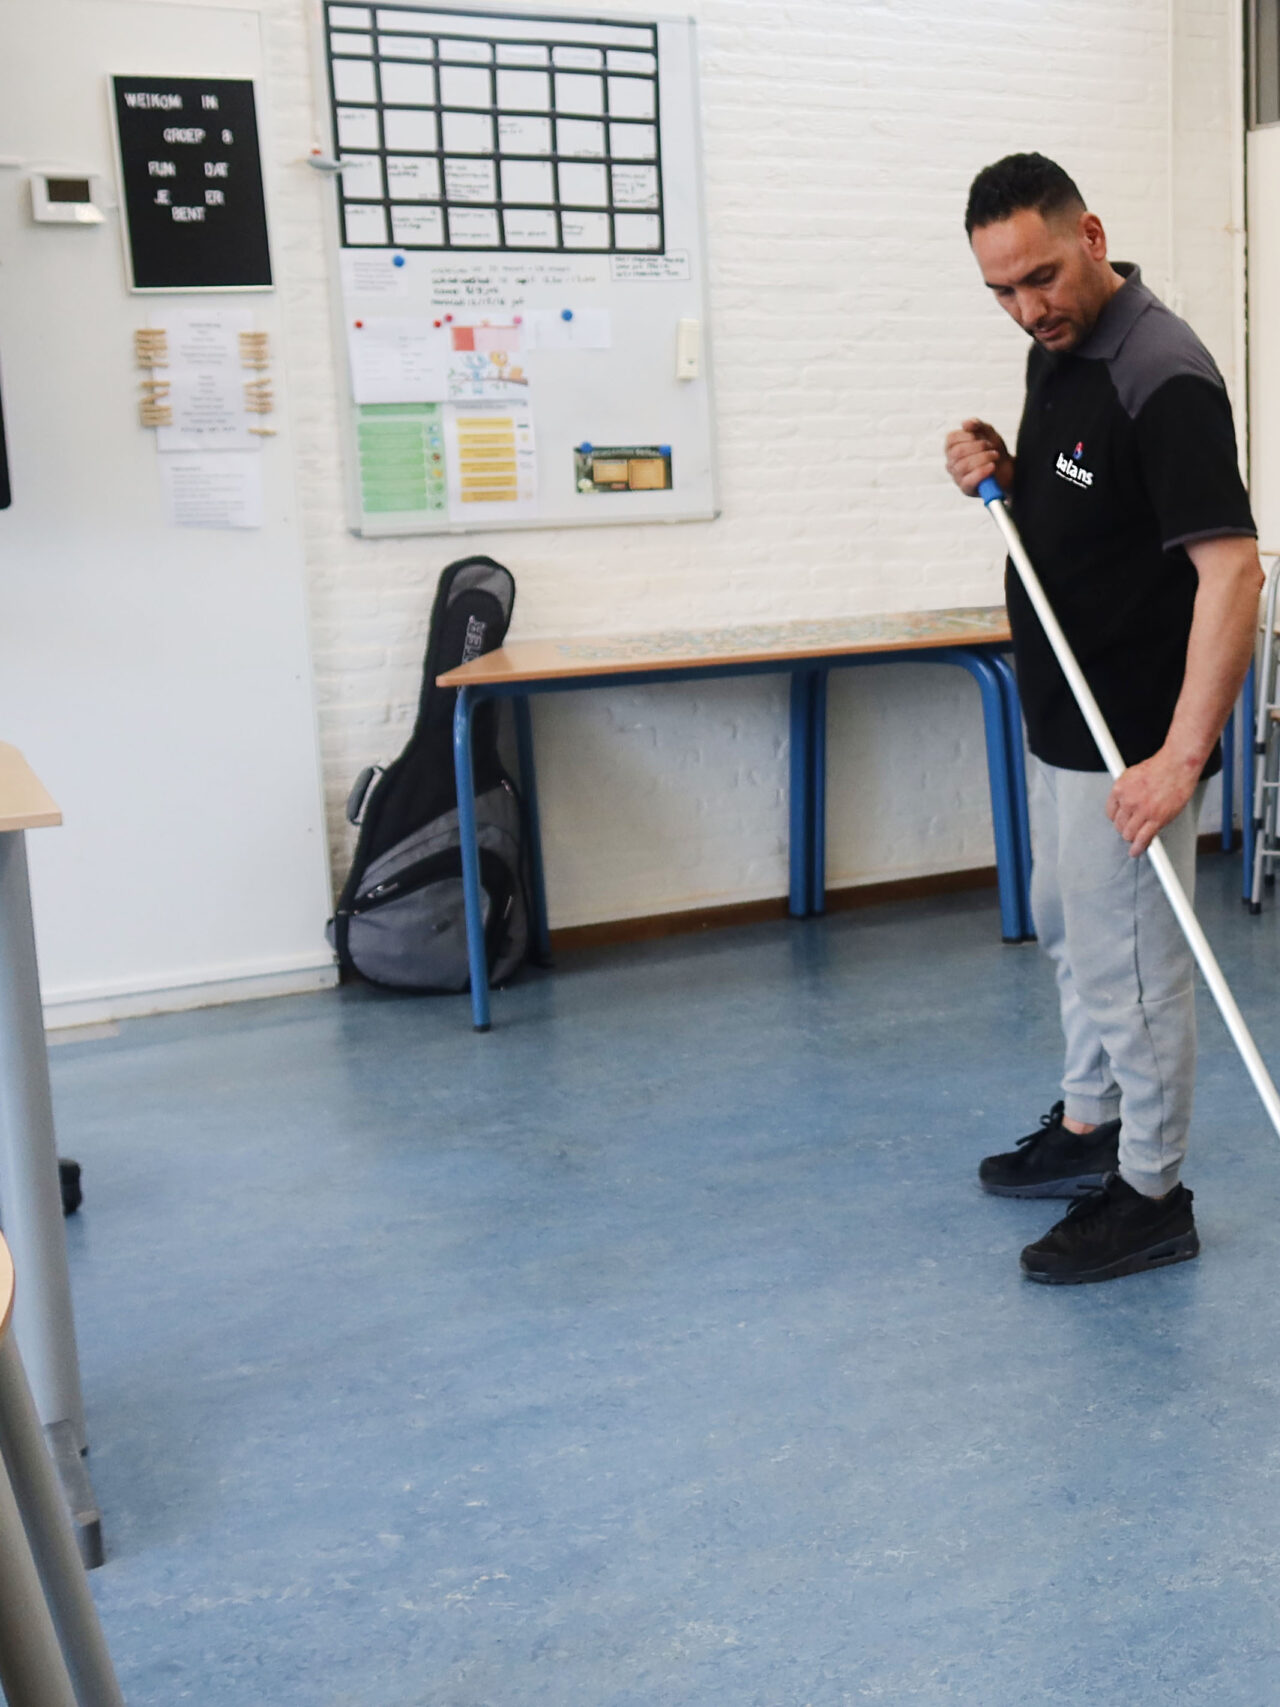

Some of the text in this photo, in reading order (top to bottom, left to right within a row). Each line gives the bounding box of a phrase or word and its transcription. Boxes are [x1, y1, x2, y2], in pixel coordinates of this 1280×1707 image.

[201, 94, 219, 110] IN
[163, 127, 206, 144] GROEP
[204, 161, 229, 178] DAT
[205, 190, 225, 206] ER
[171, 206, 206, 222] BENT
[1056, 452, 1093, 485] balans
